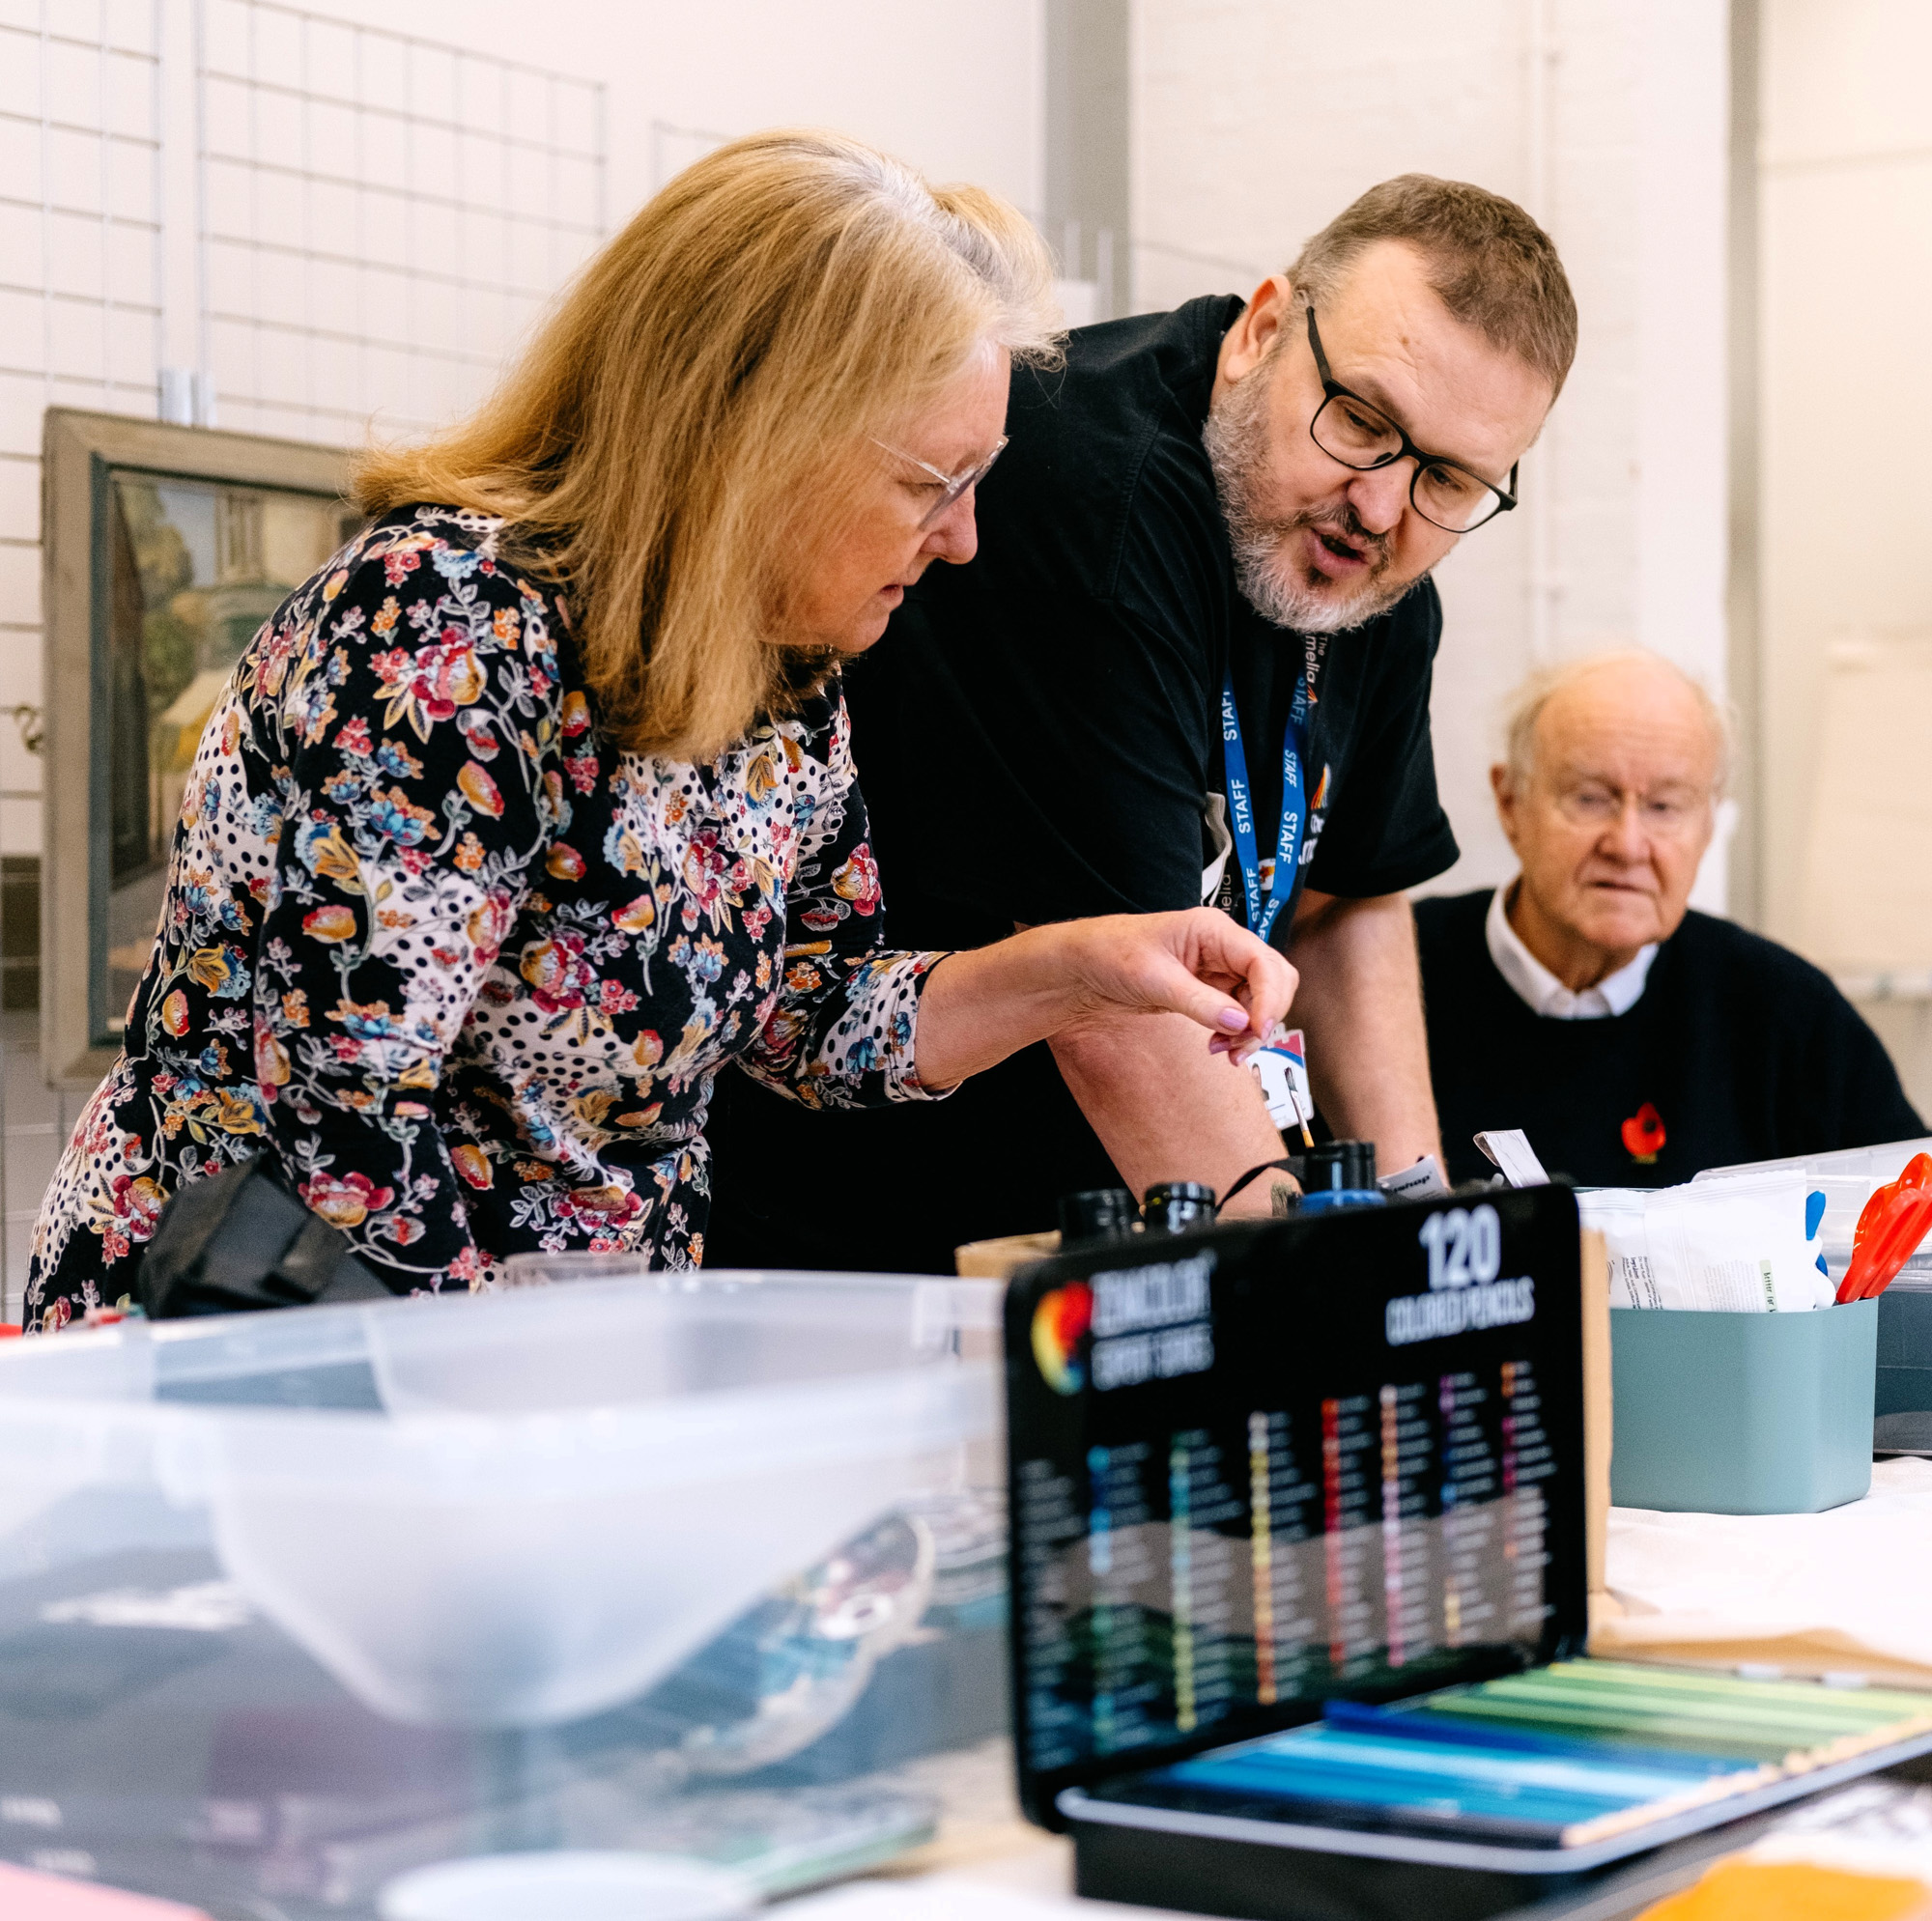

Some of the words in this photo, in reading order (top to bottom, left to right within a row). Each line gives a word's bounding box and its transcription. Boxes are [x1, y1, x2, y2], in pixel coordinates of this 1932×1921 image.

[1283, 749, 1297, 789] STAFF
[1231, 778, 1251, 834] STAFF
[1278, 810, 1298, 865] STAFF
[1245, 867, 1261, 923] STAFF
[1257, 897, 1281, 942] STAF
[1418, 1203, 1501, 1291] 120
